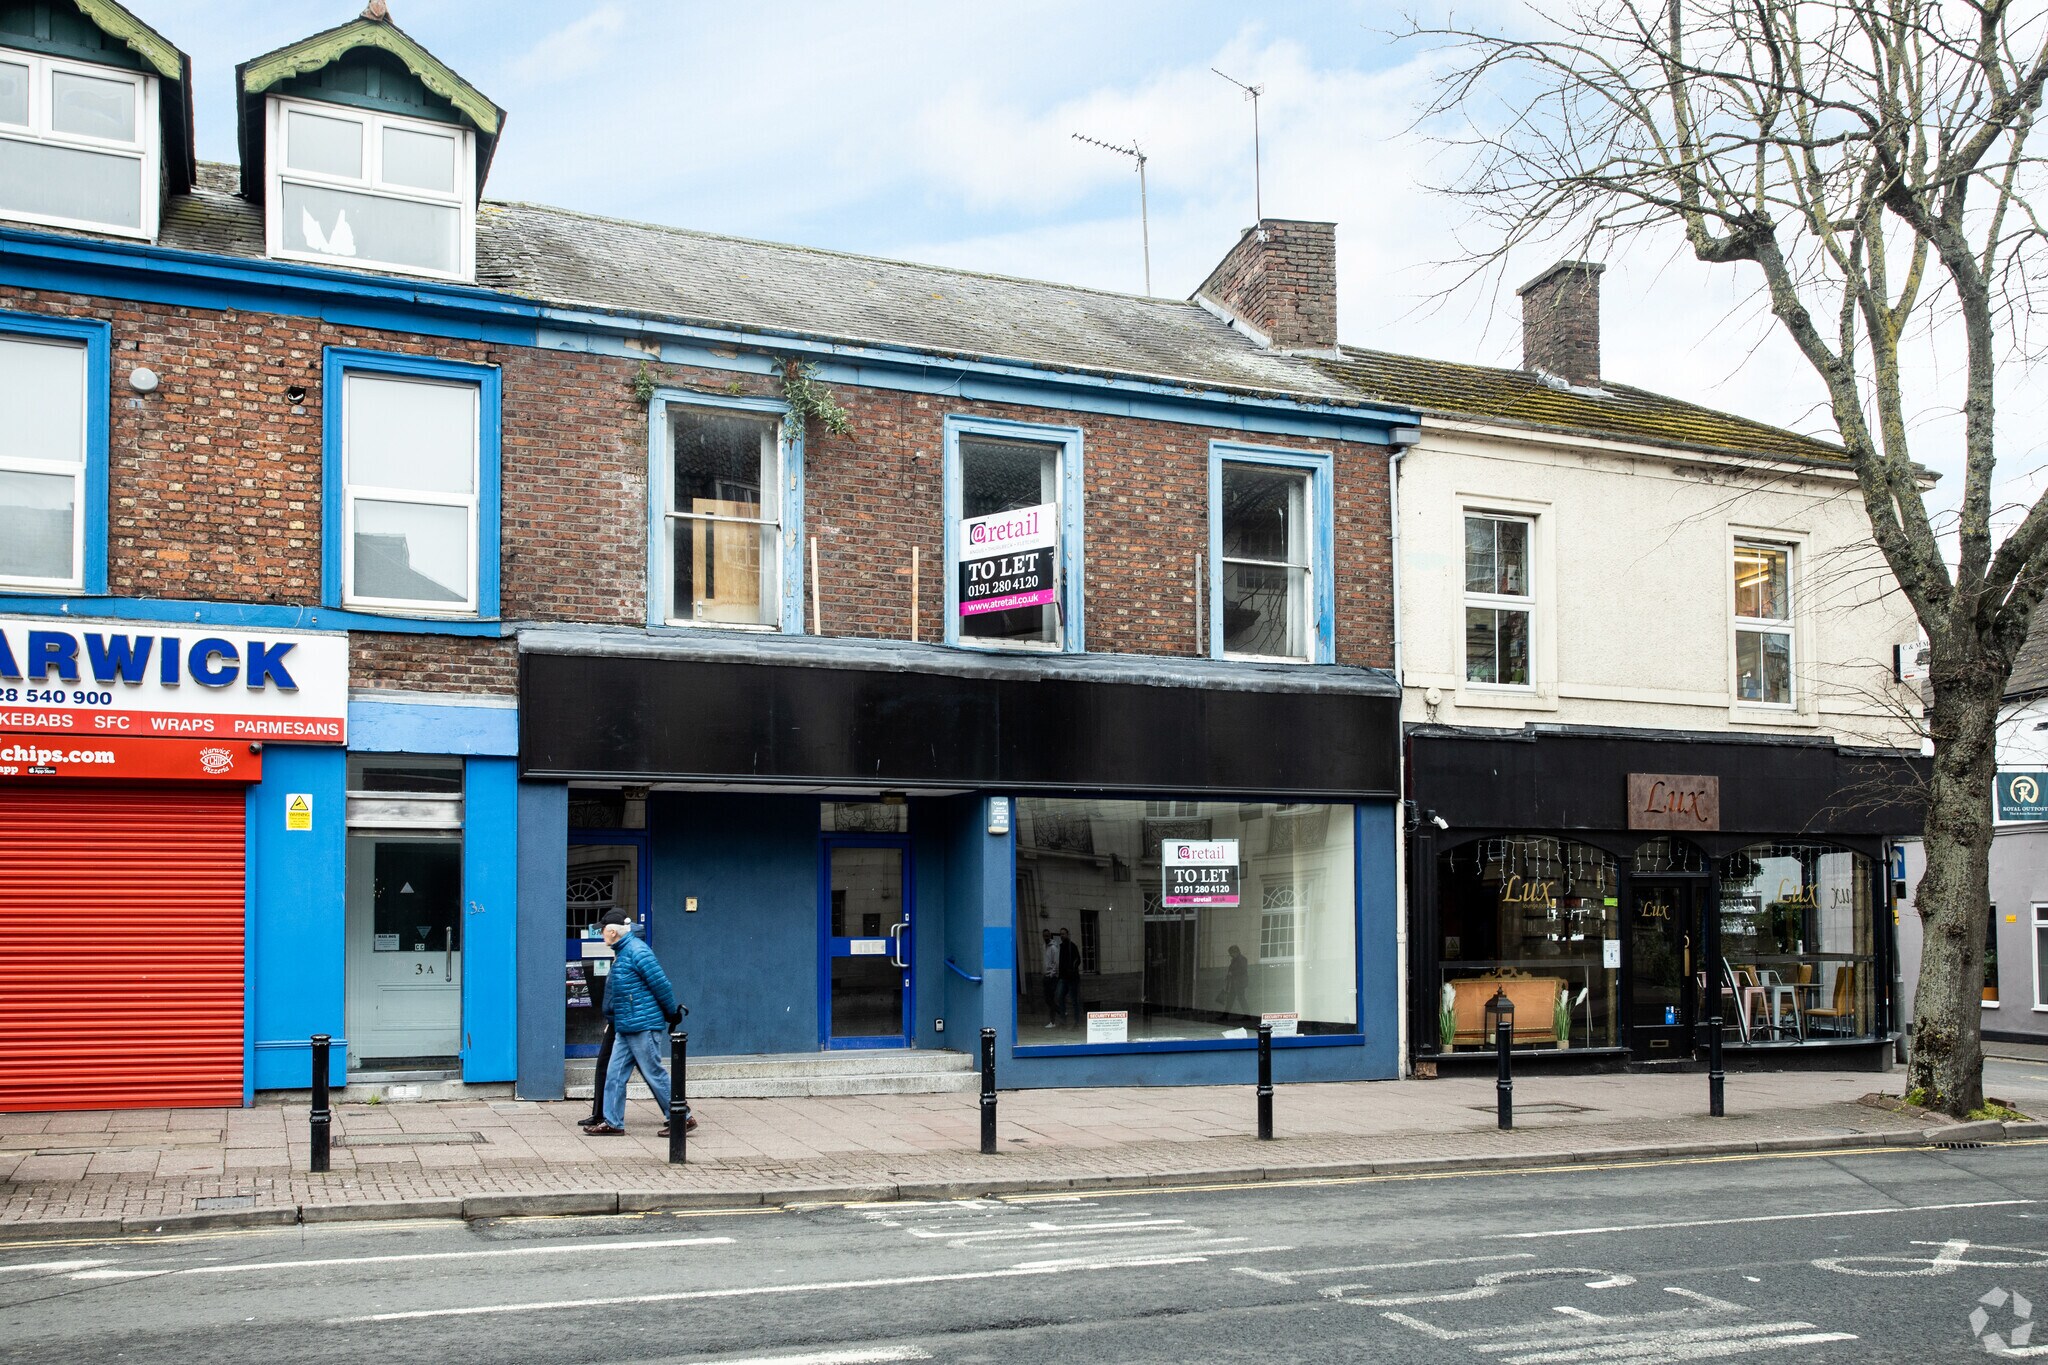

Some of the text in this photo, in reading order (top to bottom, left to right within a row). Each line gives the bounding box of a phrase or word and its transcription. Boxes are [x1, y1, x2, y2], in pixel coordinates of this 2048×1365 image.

[970, 512, 1039, 545] @retail
[968, 553, 1039, 582] TO LET
[968, 575, 1039, 597] 0191 280 4120
[968, 593, 1039, 612] www.atretail.co.uk
[26, 689, 66, 703] 540
[73, 691, 112, 705] 900
[0, 712, 339, 736] KEBABS SFC WRAPS PARMESANS
[0, 745, 115, 766] chips.com
[1643, 781, 1708, 822] Lux
[1178, 845, 1224, 859] @retail
[1174, 869, 1229, 883] TO LET
[1174, 885, 1230, 893] 0191 280 4120
[1502, 875, 1554, 908] Lux
[1775, 878, 1821, 909] Lux
[469, 901, 485, 915] 3A
[1641, 901, 1671, 920] Lux
